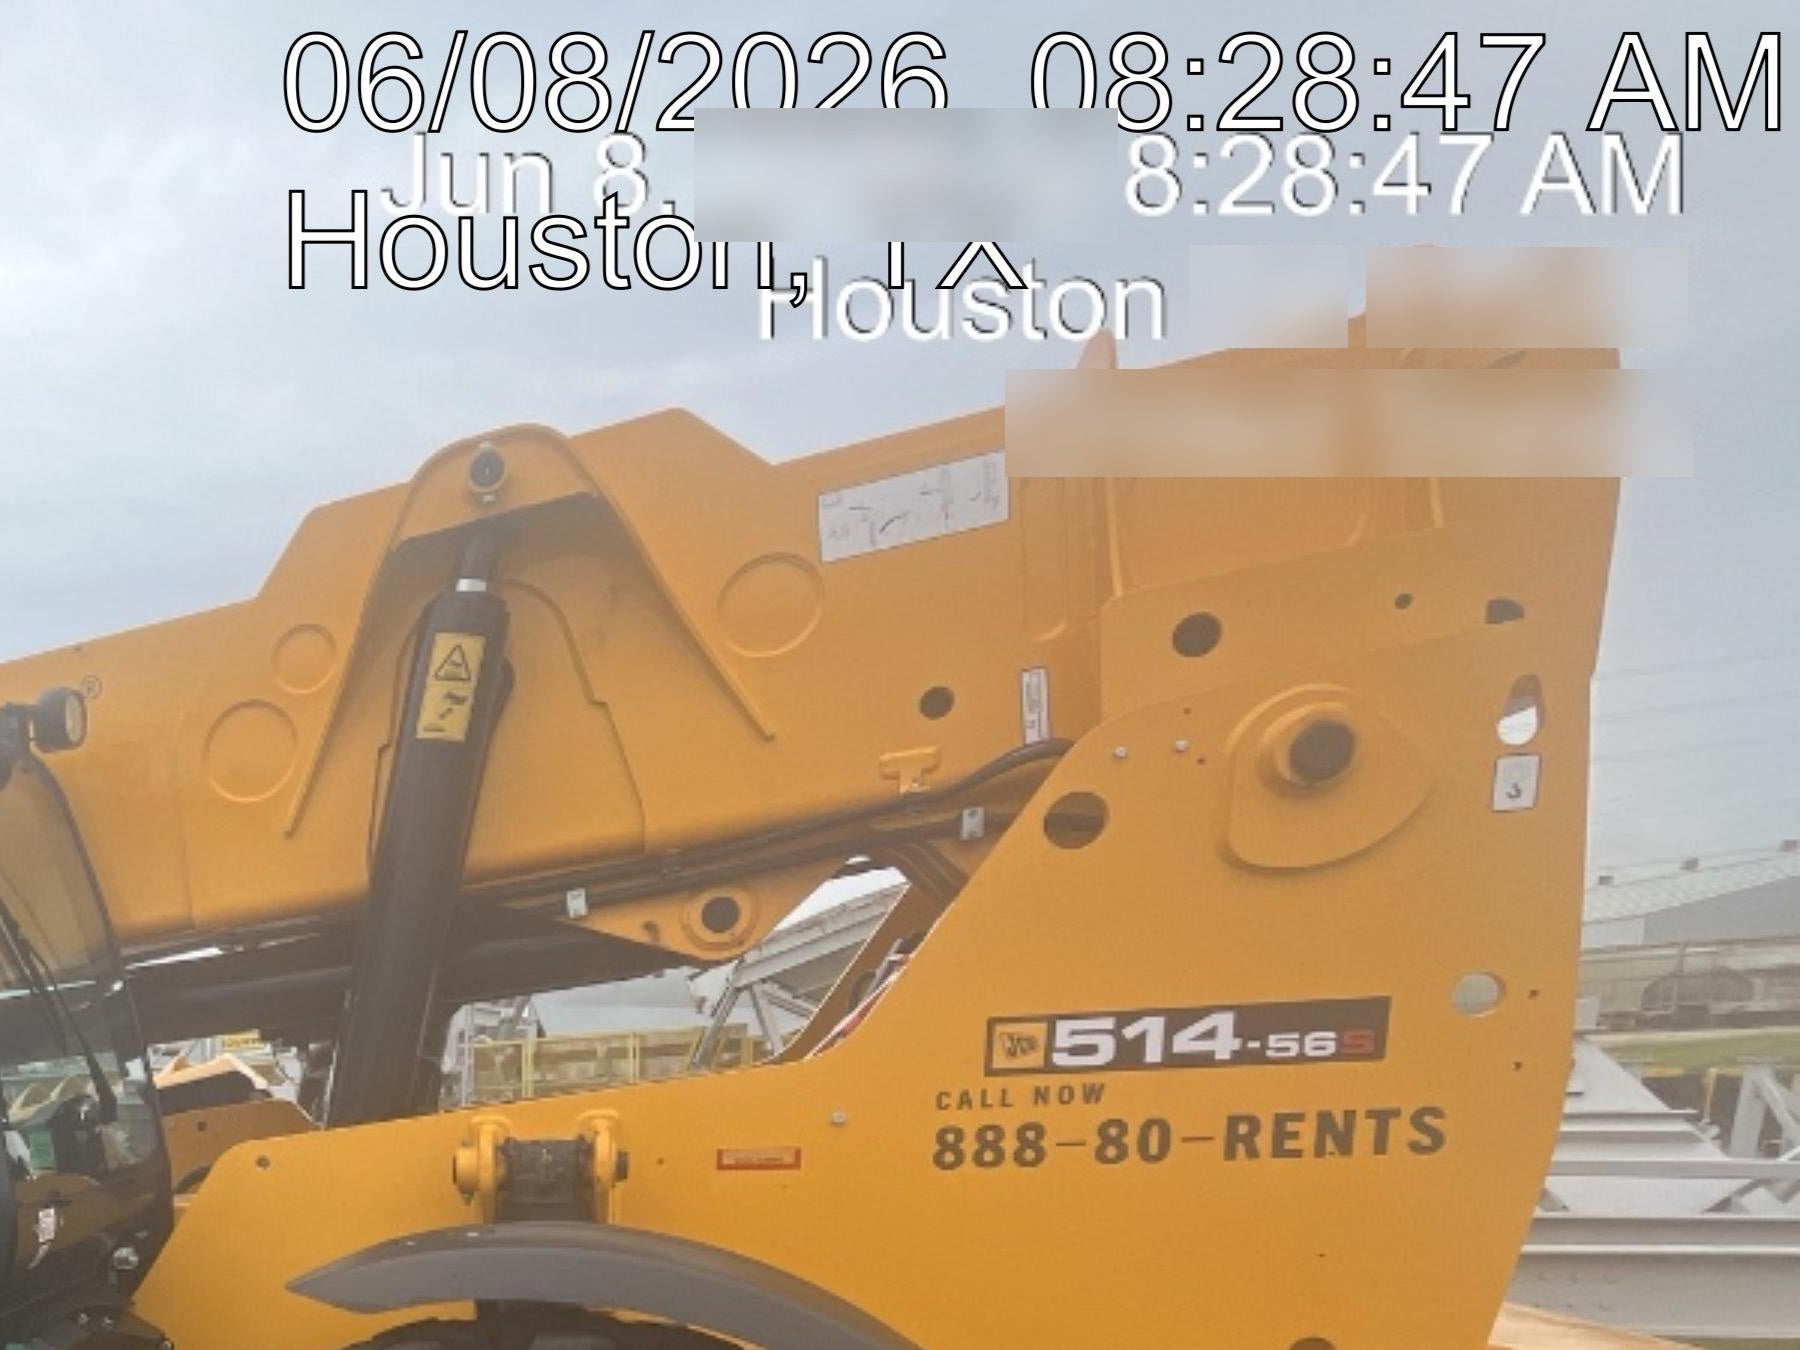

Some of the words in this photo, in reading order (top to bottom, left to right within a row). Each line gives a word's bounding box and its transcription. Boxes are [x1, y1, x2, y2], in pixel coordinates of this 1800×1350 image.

[936, 1090, 1014, 1111] CALL
[1033, 1082, 1107, 1107] NOW
[932, 1106, 1447, 1171] 888-80-RENTS
